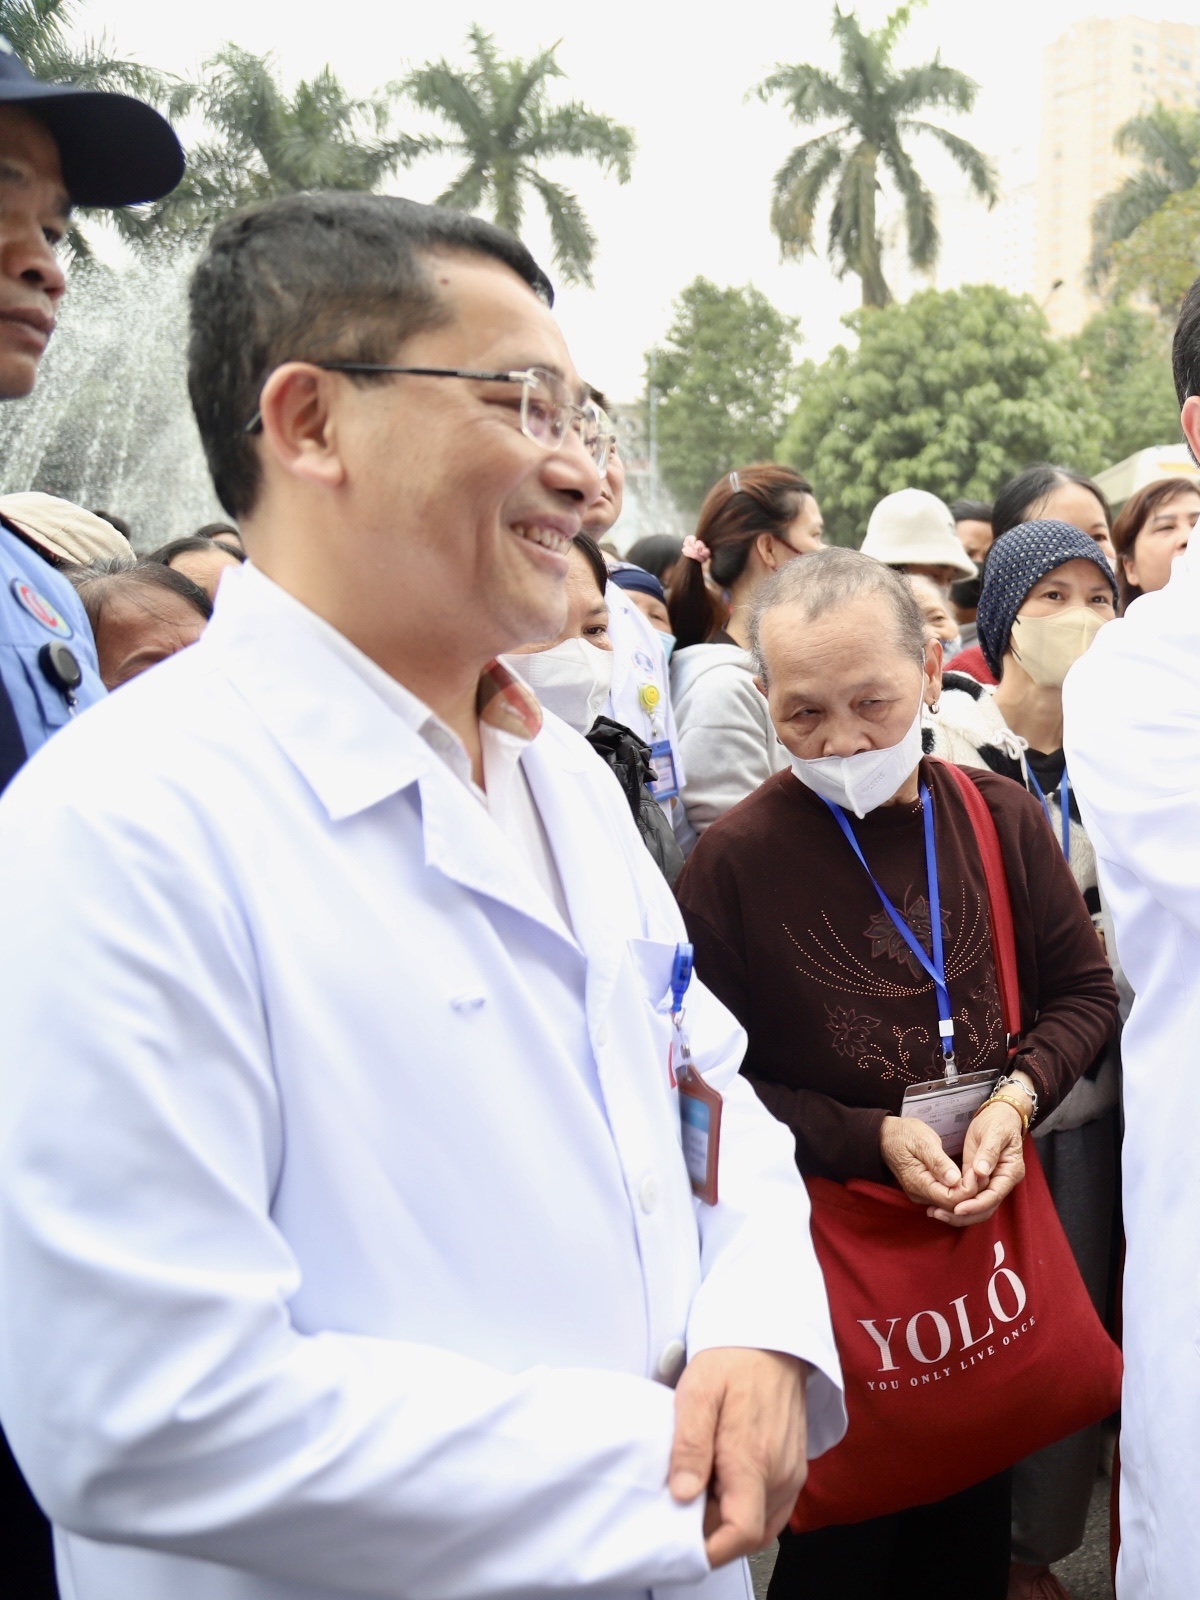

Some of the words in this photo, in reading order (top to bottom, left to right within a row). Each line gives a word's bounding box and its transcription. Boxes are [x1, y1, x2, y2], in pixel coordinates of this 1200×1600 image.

[856, 1240, 1027, 1372] YOLÓ
[867, 1380, 899, 1391] YOU
[909, 1367, 951, 1387] ONLY
[960, 1345, 995, 1371] LIVE
[1002, 1315, 1036, 1346] ONCE
